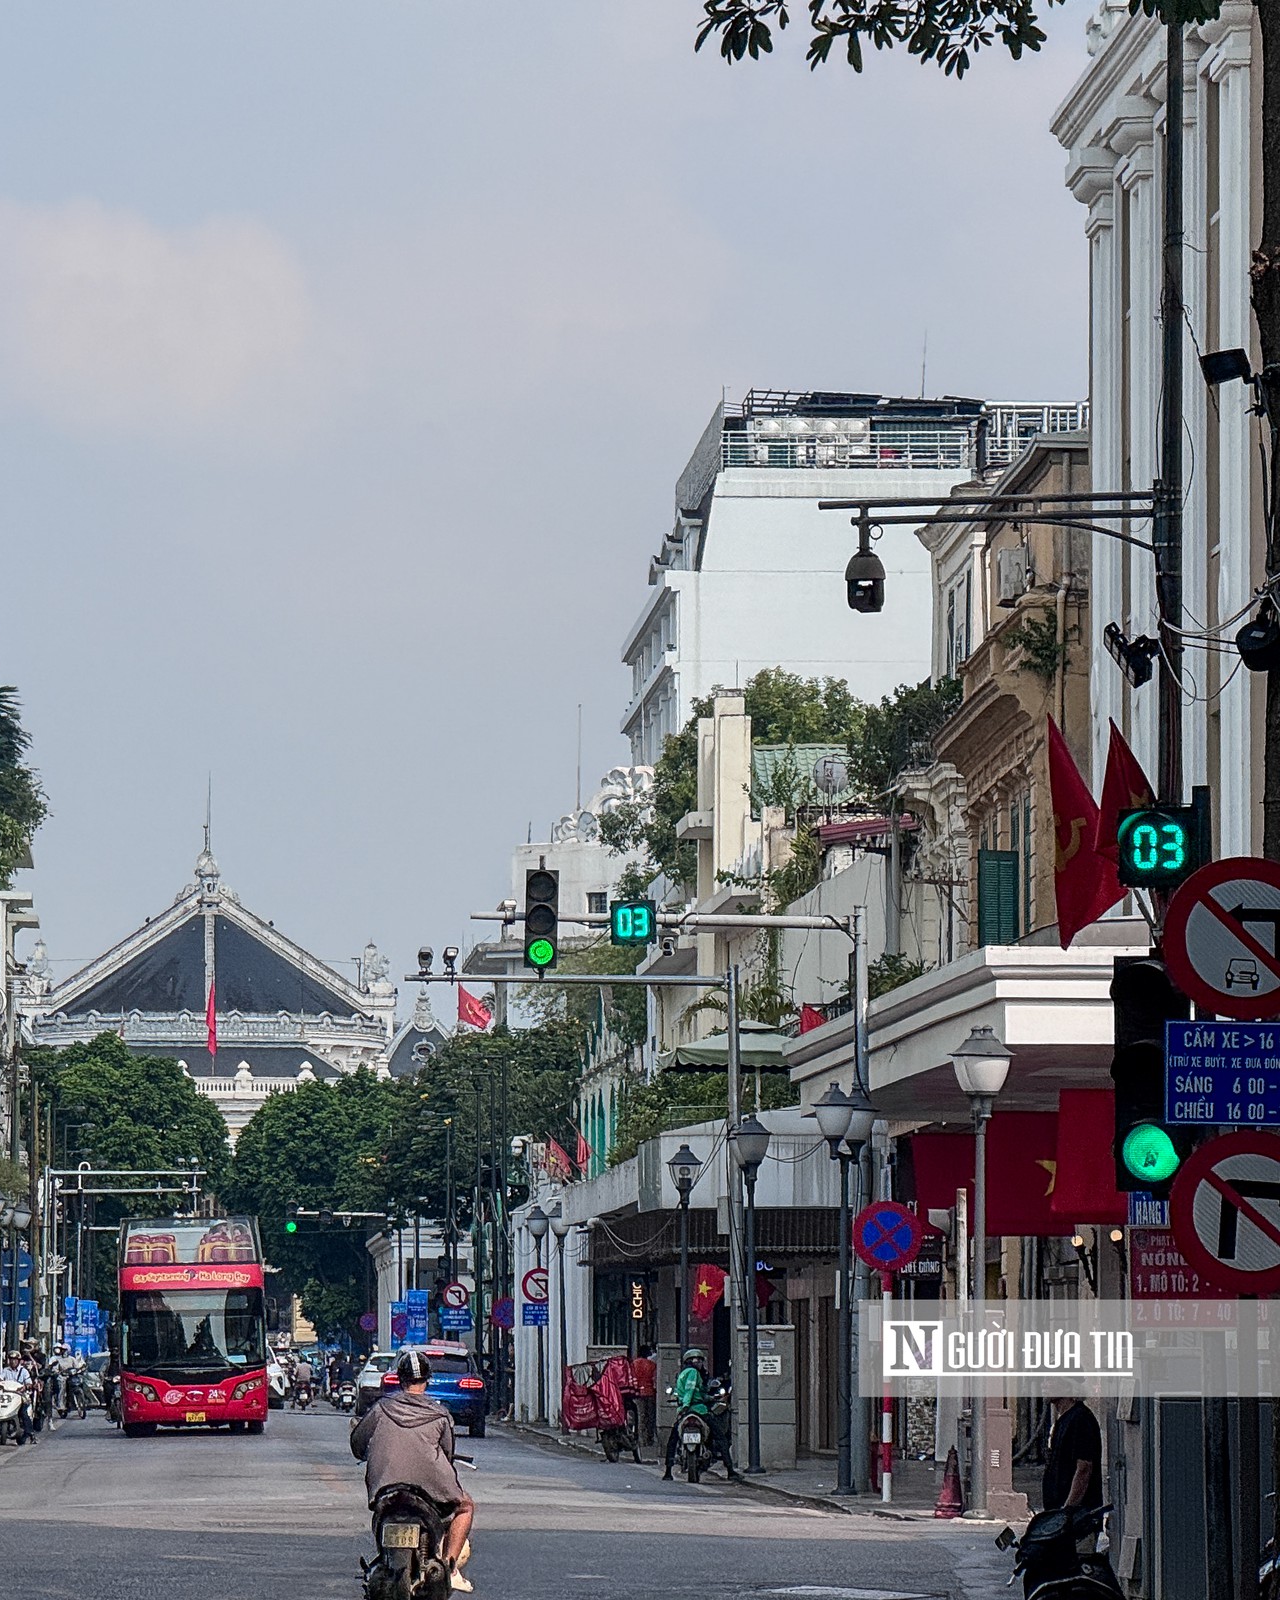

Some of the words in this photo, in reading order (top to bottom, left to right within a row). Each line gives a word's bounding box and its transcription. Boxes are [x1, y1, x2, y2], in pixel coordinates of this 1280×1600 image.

[1133, 824, 1184, 869] 03
[617, 907, 648, 937] 03
[1183, 1025, 1215, 1049] CẤM
[1222, 1031, 1240, 1049] XE
[1259, 1032, 1274, 1050] 16
[1191, 1055, 1202, 1068] XE
[1231, 1057, 1242, 1069] XE
[1245, 1056, 1262, 1069] ĐƯA
[1175, 1071, 1213, 1094] SÁNG
[1174, 1095, 1215, 1119] CHIỀU
[1135, 1195, 1162, 1225] HÀNG
[1149, 1270, 1168, 1292] MÔ
